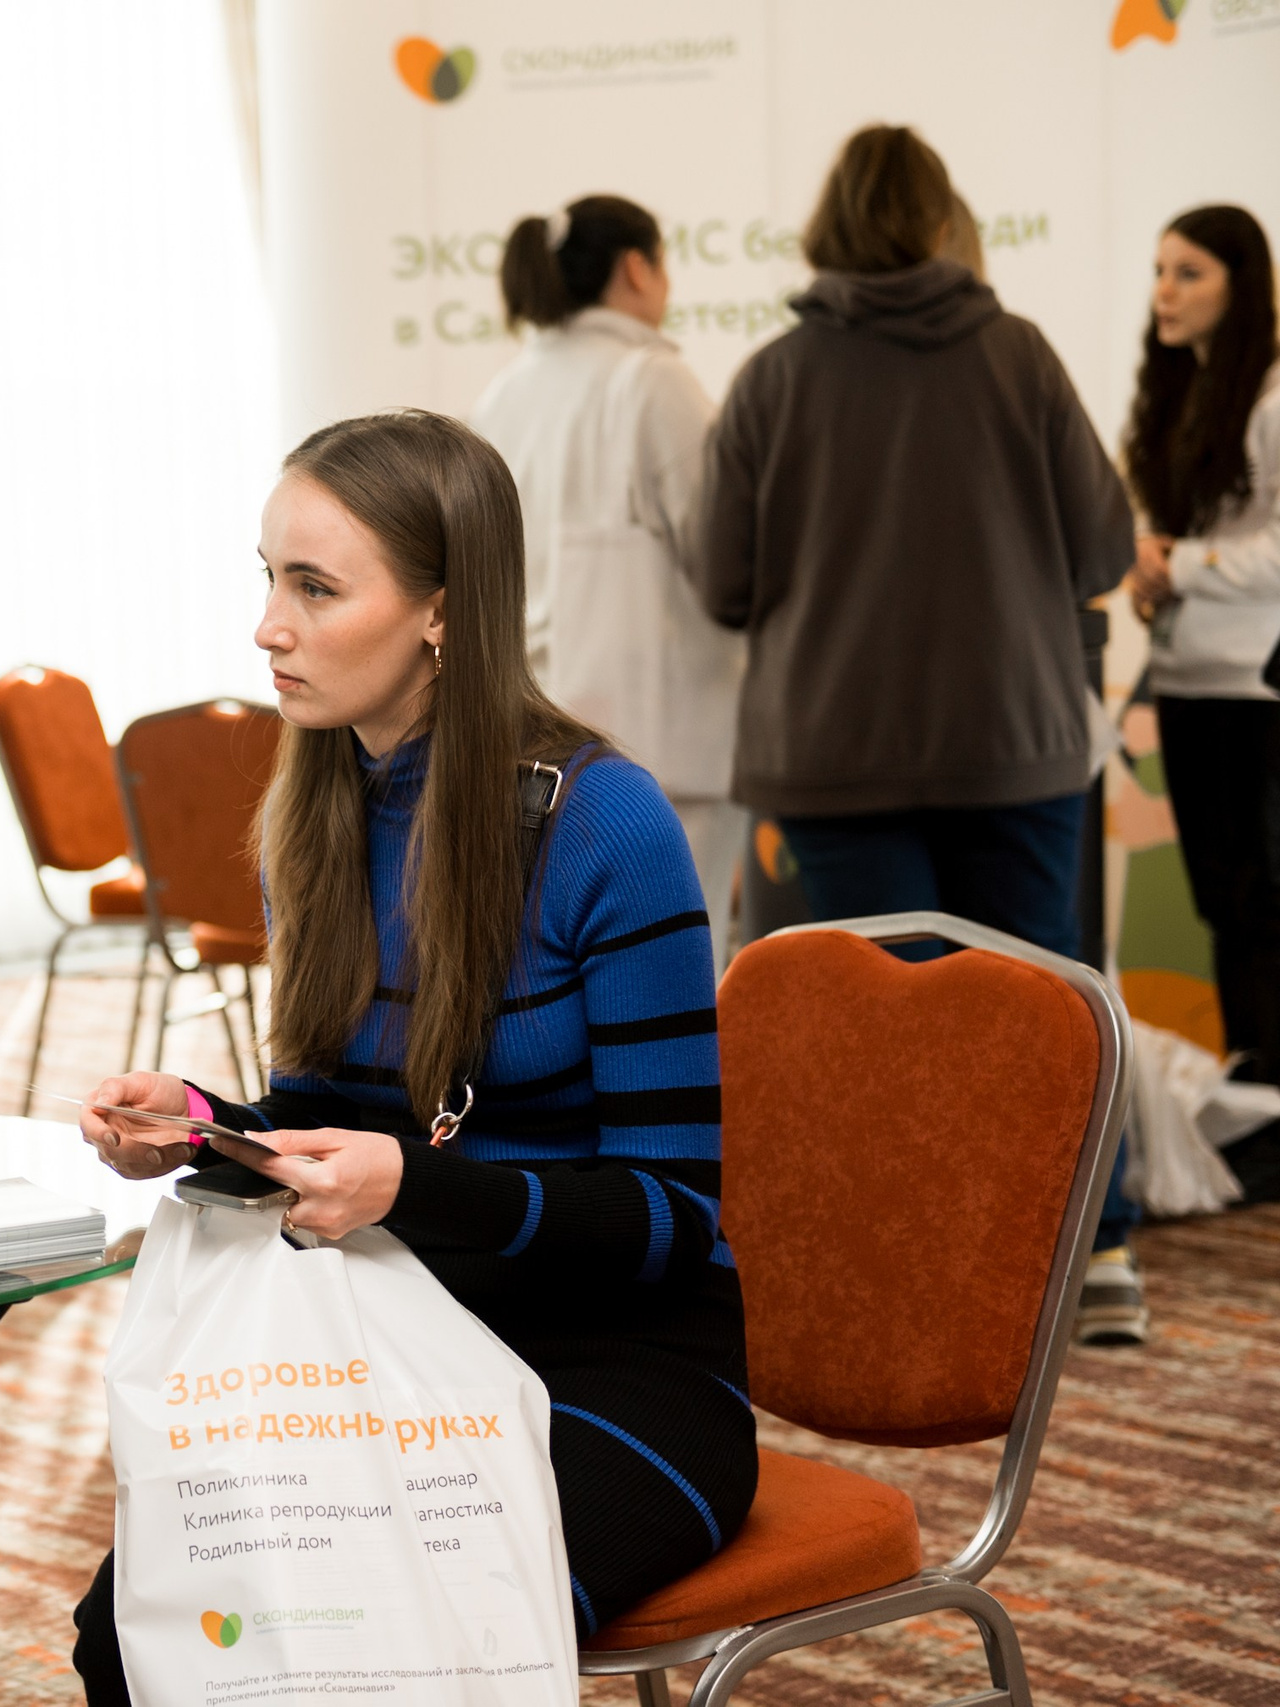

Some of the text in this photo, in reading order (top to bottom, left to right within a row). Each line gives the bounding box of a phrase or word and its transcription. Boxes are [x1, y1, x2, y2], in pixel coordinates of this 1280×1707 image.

[742, 218, 804, 263] бе
[165, 1359, 369, 1405] Здоровье
[169, 1424, 191, 1450] в
[394, 1415, 504, 1454] руках
[177, 1474, 308, 1498] Поликлиника
[406, 1473, 478, 1491] ационар
[184, 1505, 392, 1531] Клиника репродукции
[414, 1501, 503, 1521] агностика
[188, 1532, 332, 1562] Родильный дом
[424, 1538, 461, 1553] тека
[205, 1676, 260, 1692] Получайте
[271, 1671, 312, 1683] храните
[314, 1670, 369, 1681] результаты
[371, 1666, 443, 1678] исследований
[446, 1667, 452, 1676] и
[206, 1682, 396, 1707] приложении клиники «Скандинавия»
